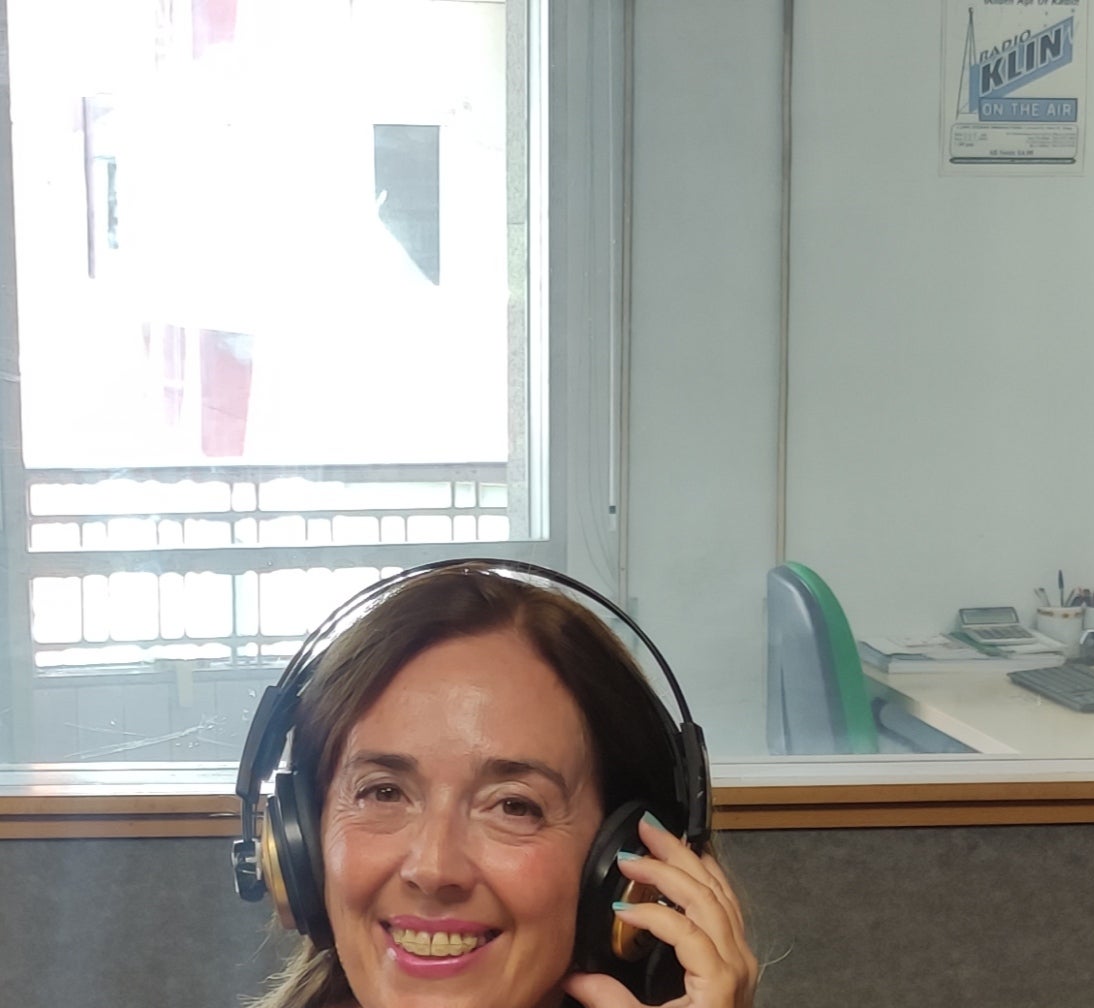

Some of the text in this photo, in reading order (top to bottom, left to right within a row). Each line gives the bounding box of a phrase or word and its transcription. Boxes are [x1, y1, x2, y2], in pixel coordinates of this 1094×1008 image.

[980, 29, 1031, 63] RADIO
[981, 26, 1062, 95] KLIN
[982, 103, 1073, 116] ON THE AIR
